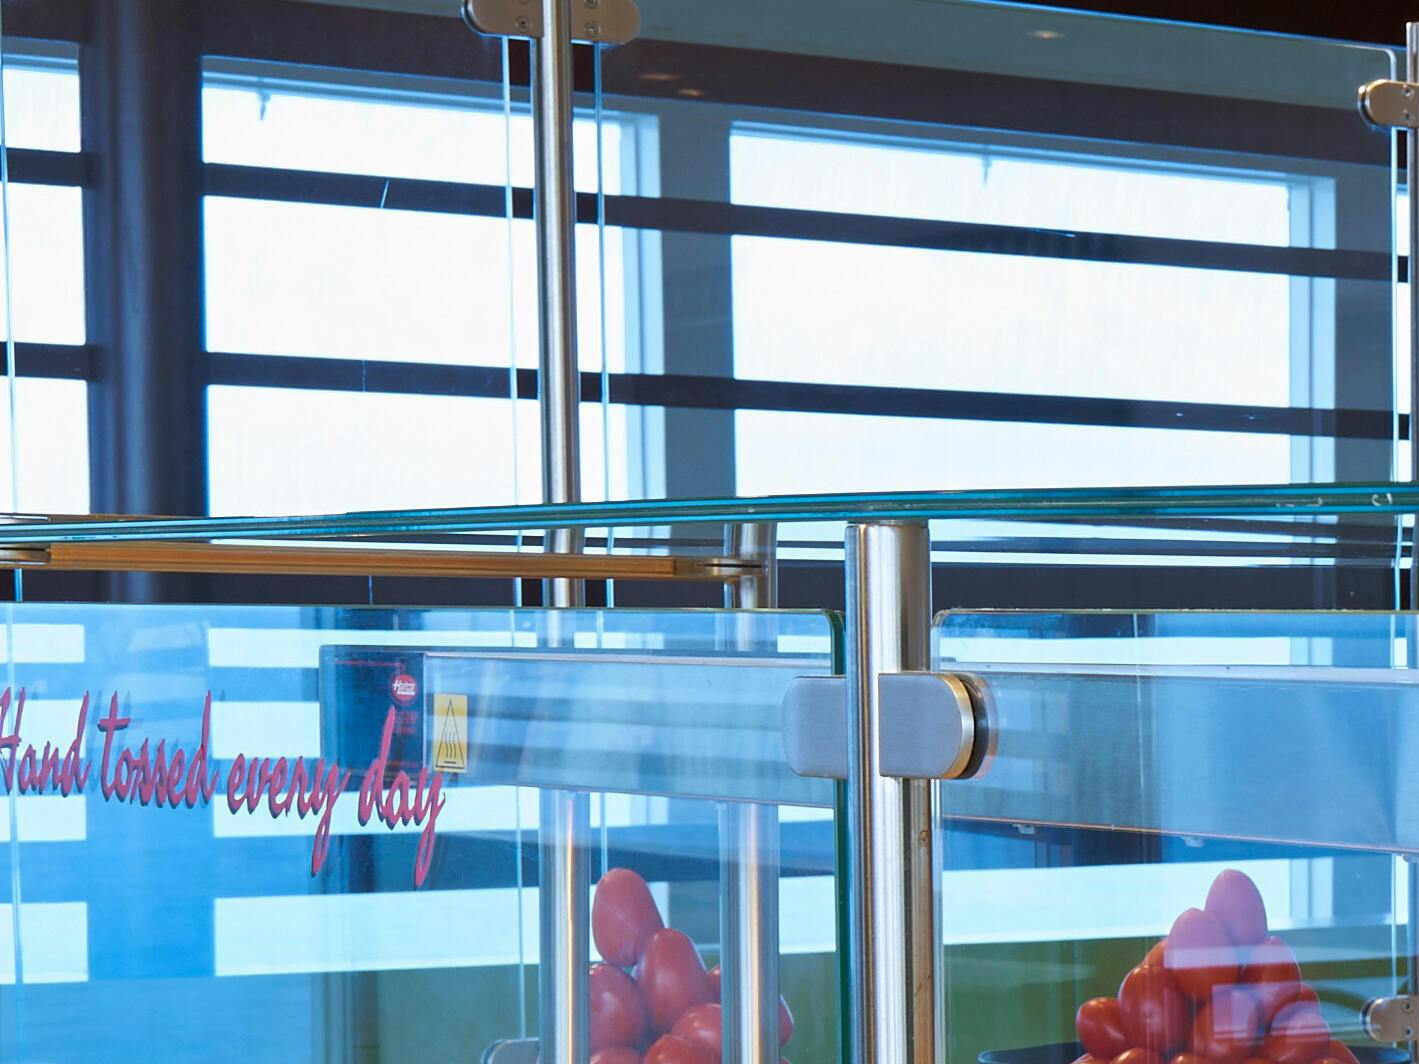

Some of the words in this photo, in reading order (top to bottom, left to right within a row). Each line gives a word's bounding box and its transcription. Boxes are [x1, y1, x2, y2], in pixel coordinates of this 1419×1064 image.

[0, 686, 91, 797] Hand
[97, 690, 219, 809] tossed
[227, 752, 350, 877] every
[358, 704, 446, 890] day
